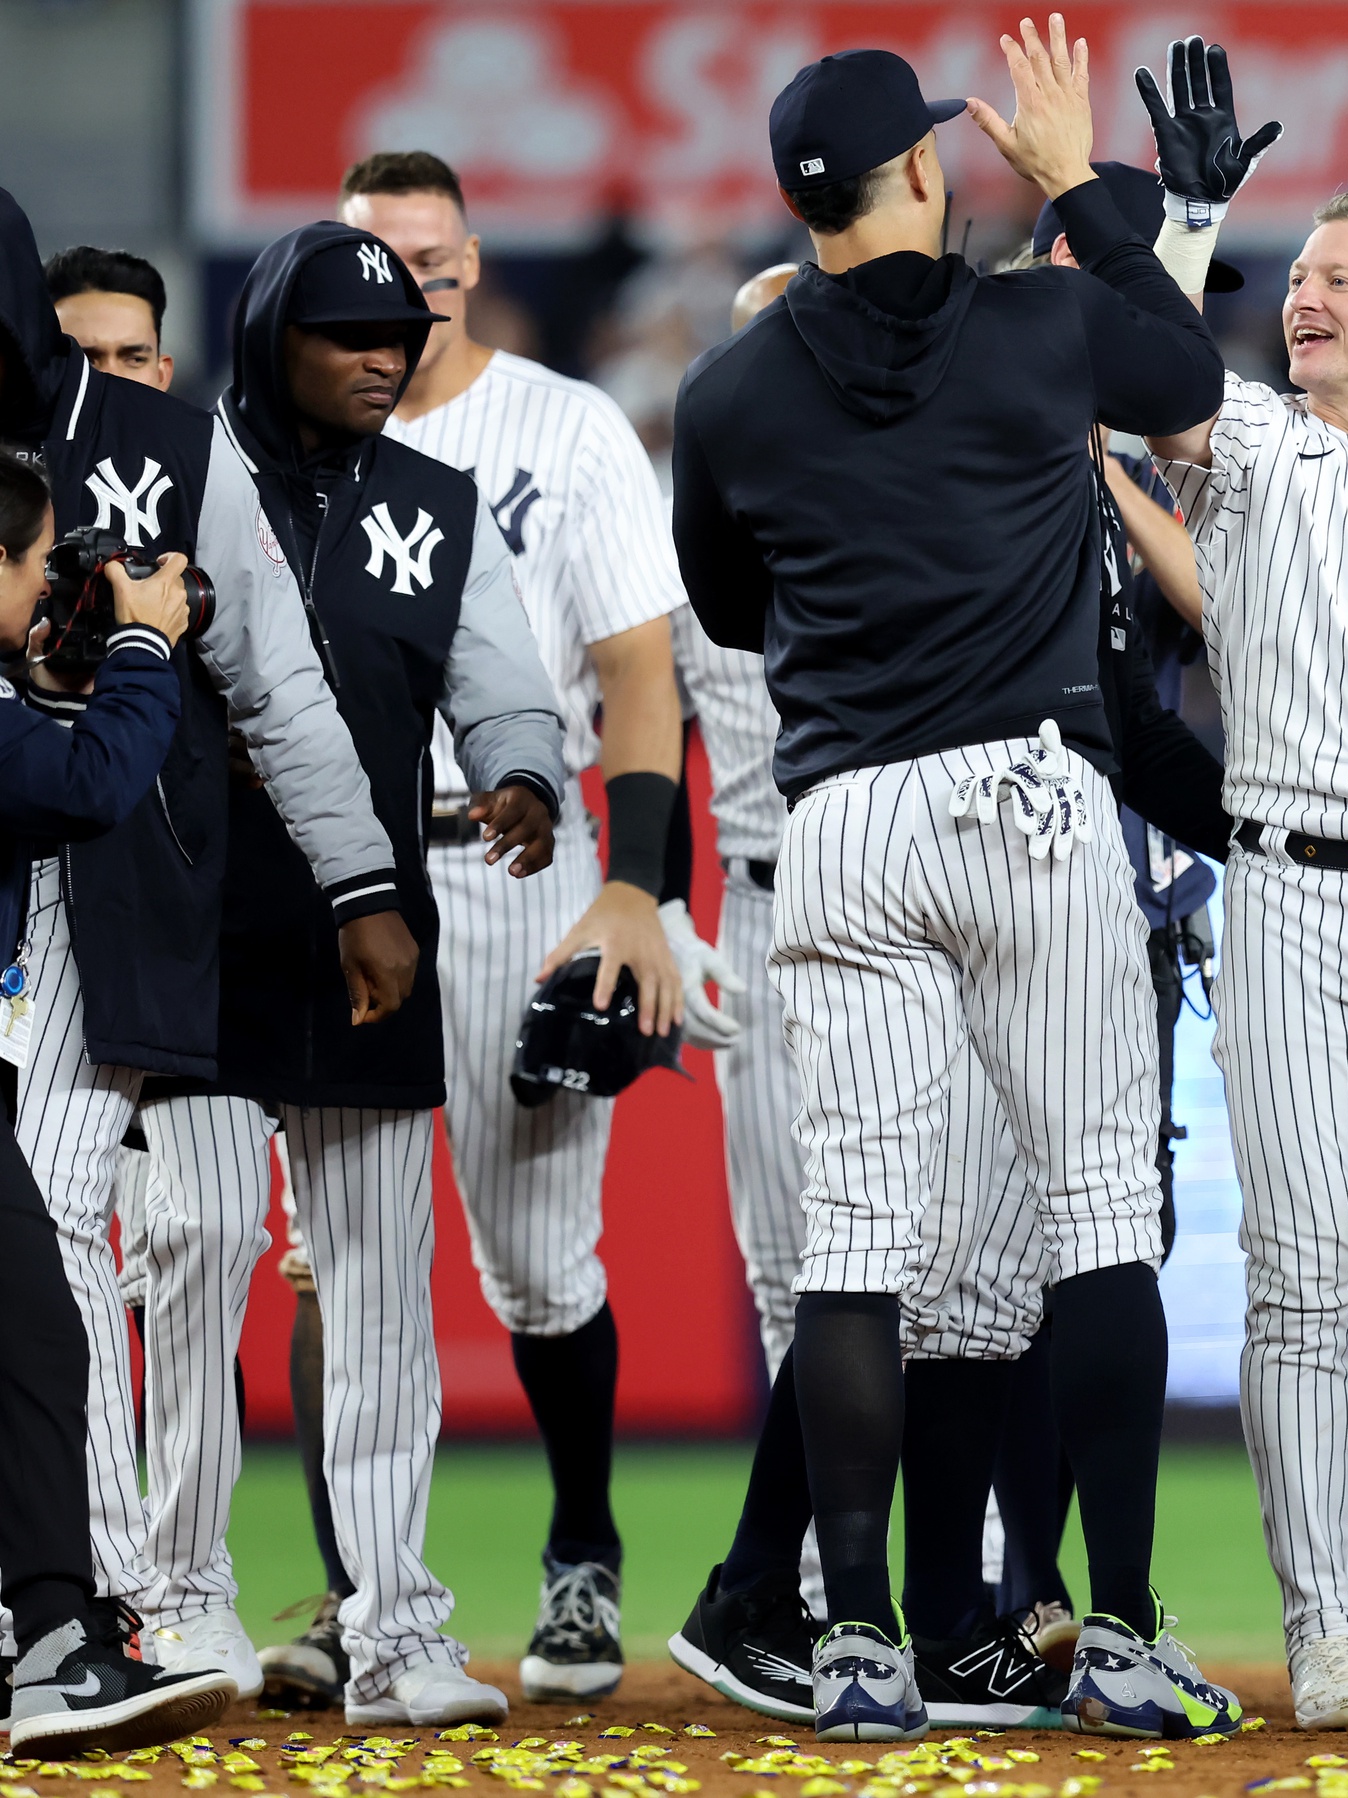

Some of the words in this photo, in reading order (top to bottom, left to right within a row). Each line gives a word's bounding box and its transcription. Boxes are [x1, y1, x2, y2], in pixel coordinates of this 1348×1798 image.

[356, 242, 394, 284] NY
[84, 456, 174, 548] NY
[360, 501, 445, 596] NY
[562, 1067, 591, 1092] 22
